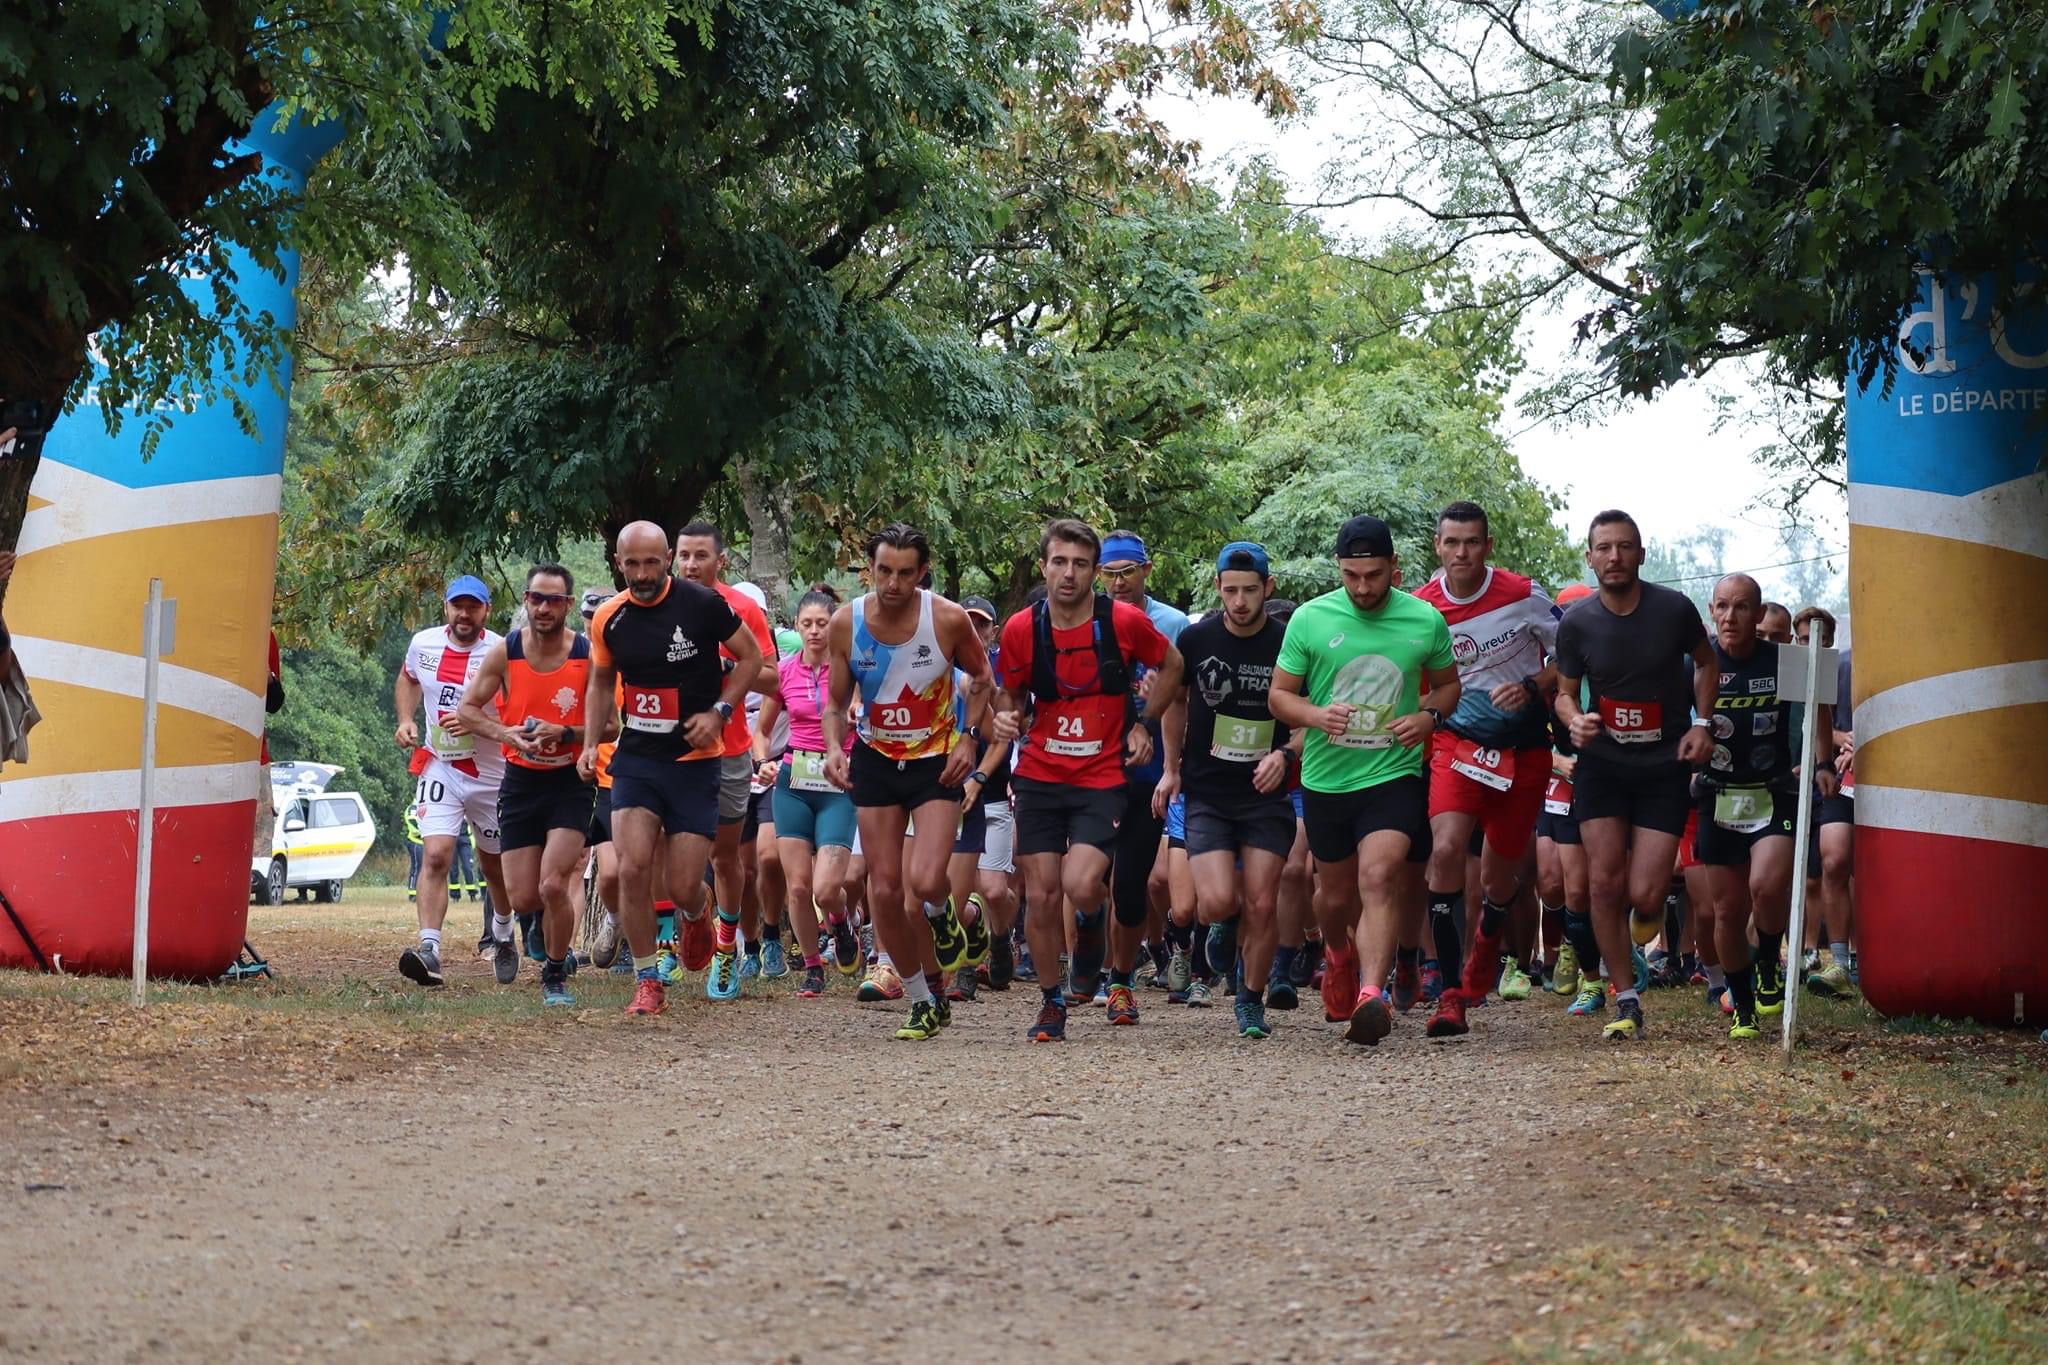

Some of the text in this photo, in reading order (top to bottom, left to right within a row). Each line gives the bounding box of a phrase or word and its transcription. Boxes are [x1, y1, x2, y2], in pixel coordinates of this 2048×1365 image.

[1900, 395, 1923, 417] LE
[666, 648, 698, 662] SEMUR
[669, 640, 695, 652] TRAIL
[635, 693, 661, 714] 23
[881, 707, 911, 726] 20
[1057, 716, 1084, 737] 24
[1347, 710, 1377, 731] 33
[1615, 707, 1643, 727] 55
[1231, 724, 1257, 745] 31
[1472, 746, 1501, 768] 49
[419, 780, 444, 803] 10
[1546, 778, 1559, 796] 7
[1732, 795, 1756, 816] 73
